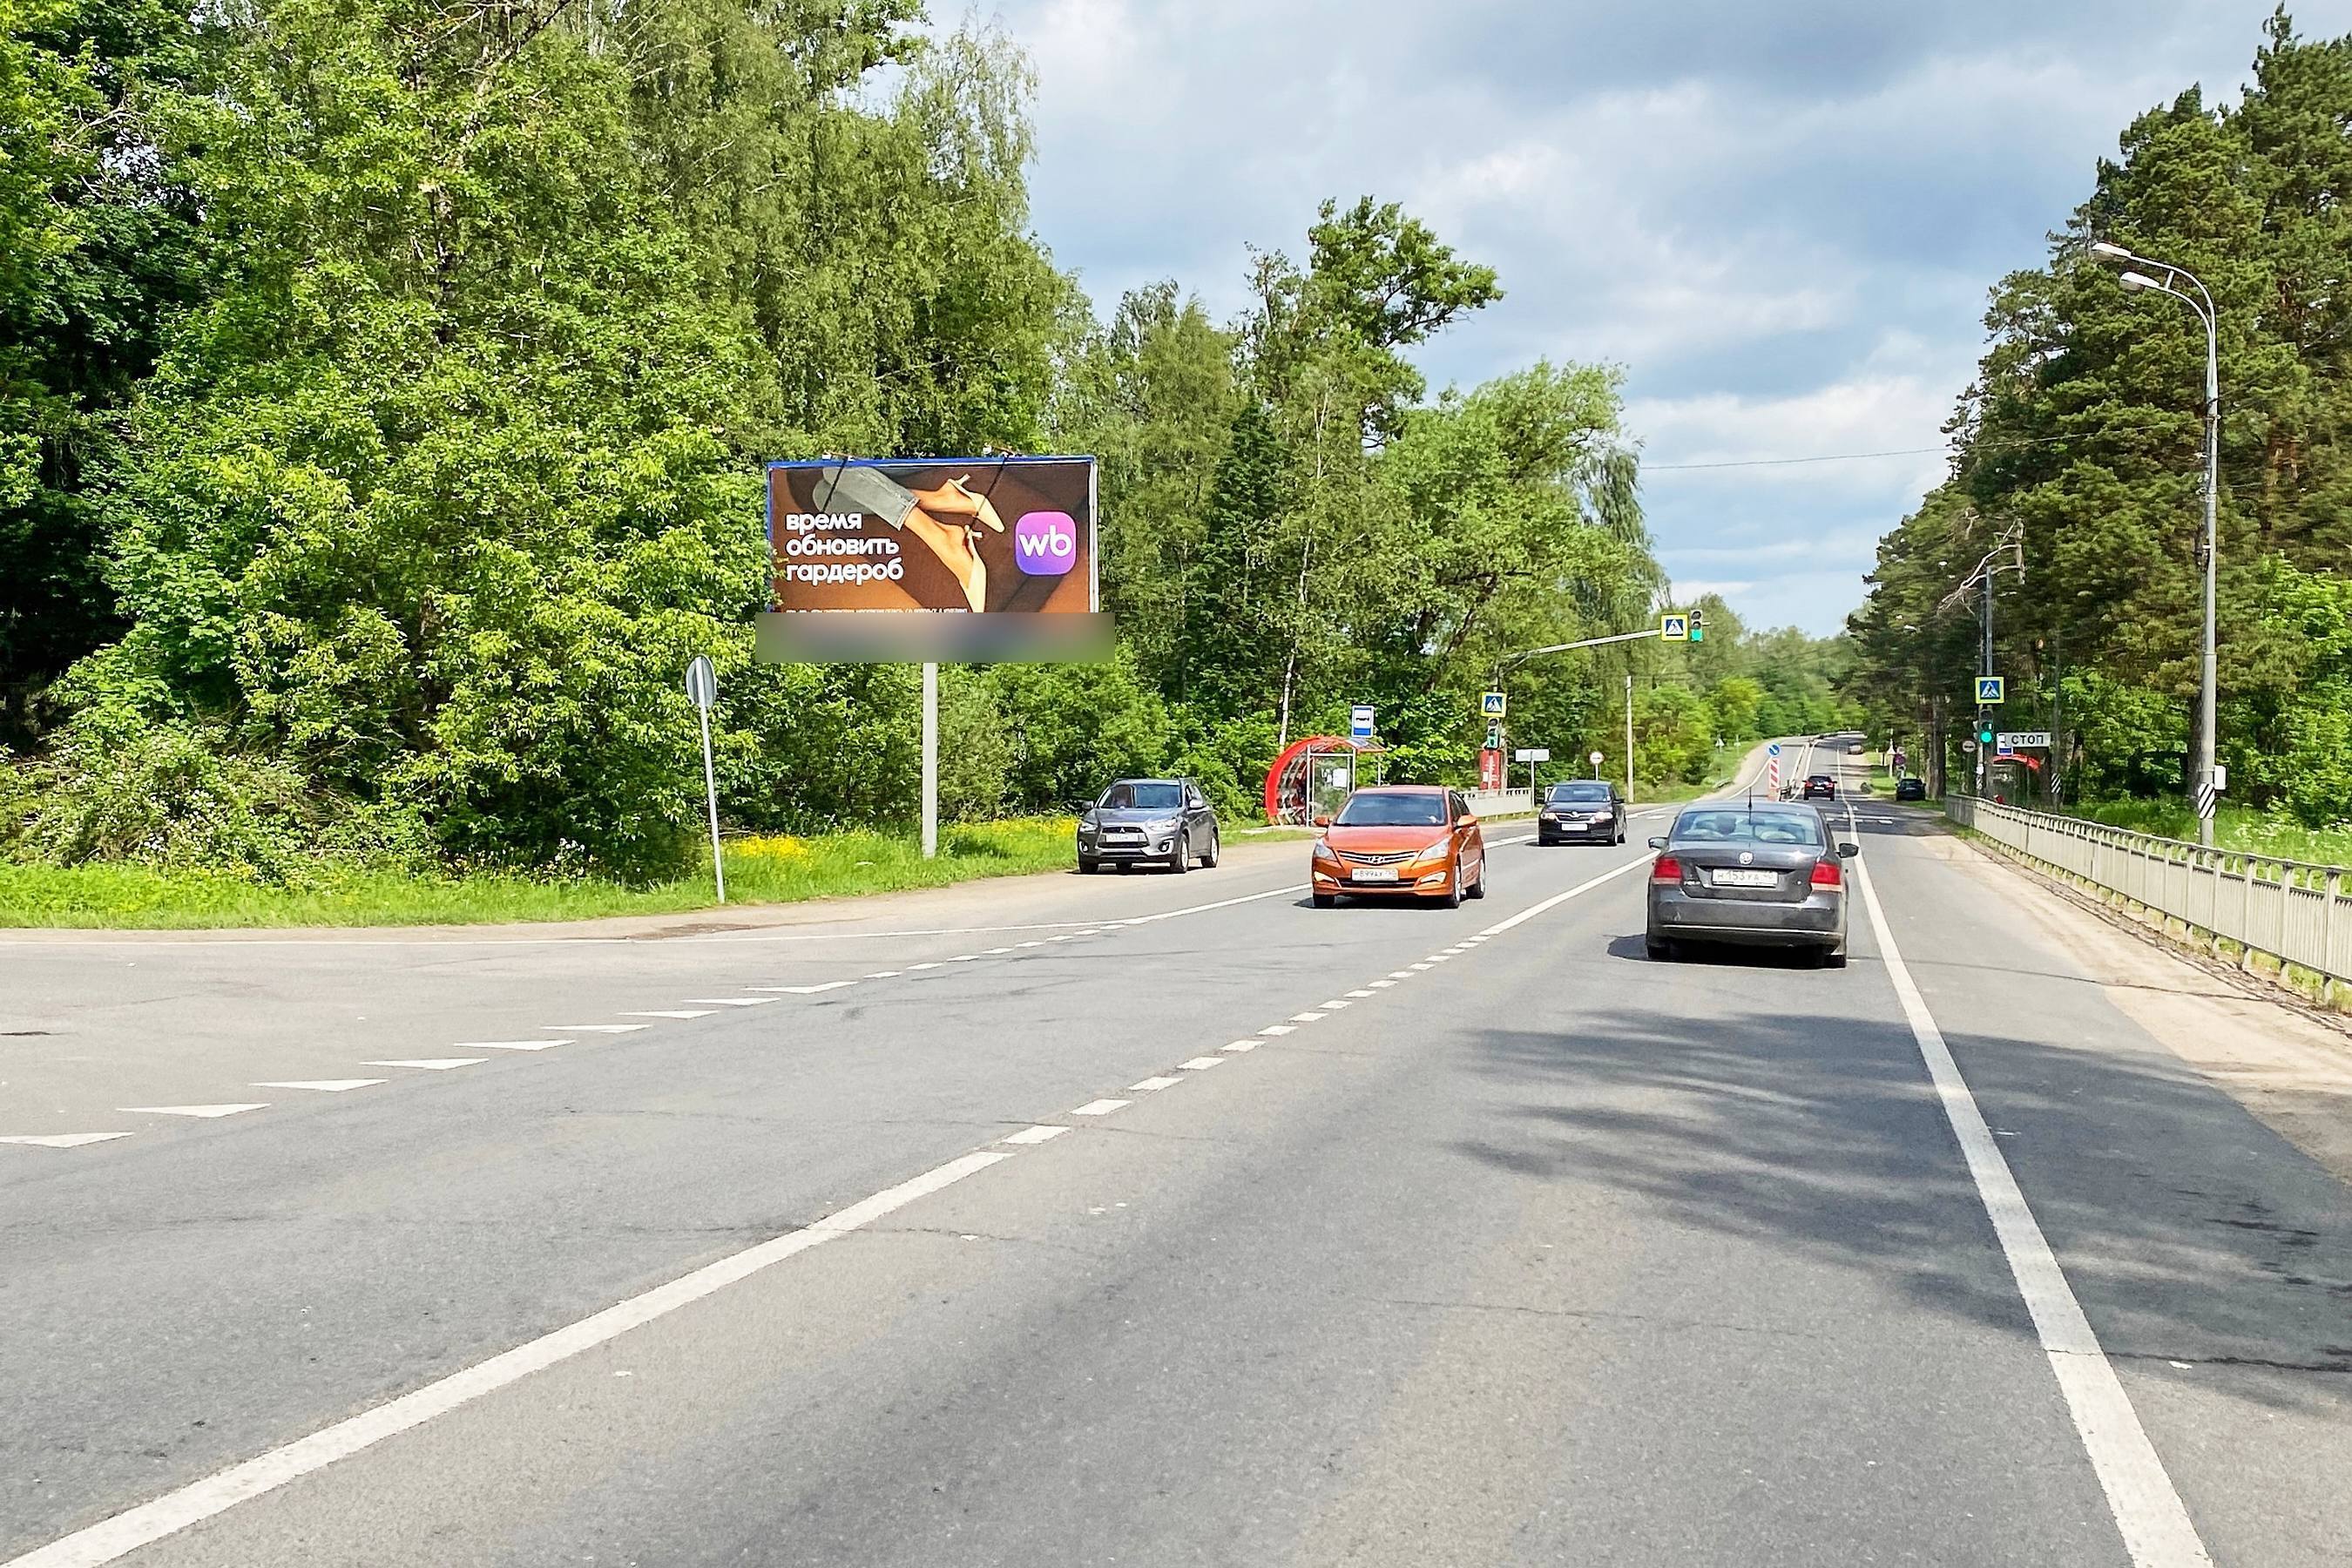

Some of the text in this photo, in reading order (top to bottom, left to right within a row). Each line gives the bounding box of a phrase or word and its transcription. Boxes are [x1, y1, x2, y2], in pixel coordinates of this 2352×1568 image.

[786, 513, 862, 536] время
[786, 533, 900, 557] обновить
[1018, 524, 1073, 558] wb
[786, 558, 904, 586] гардероб
[2011, 734, 2044, 745] СТОП
